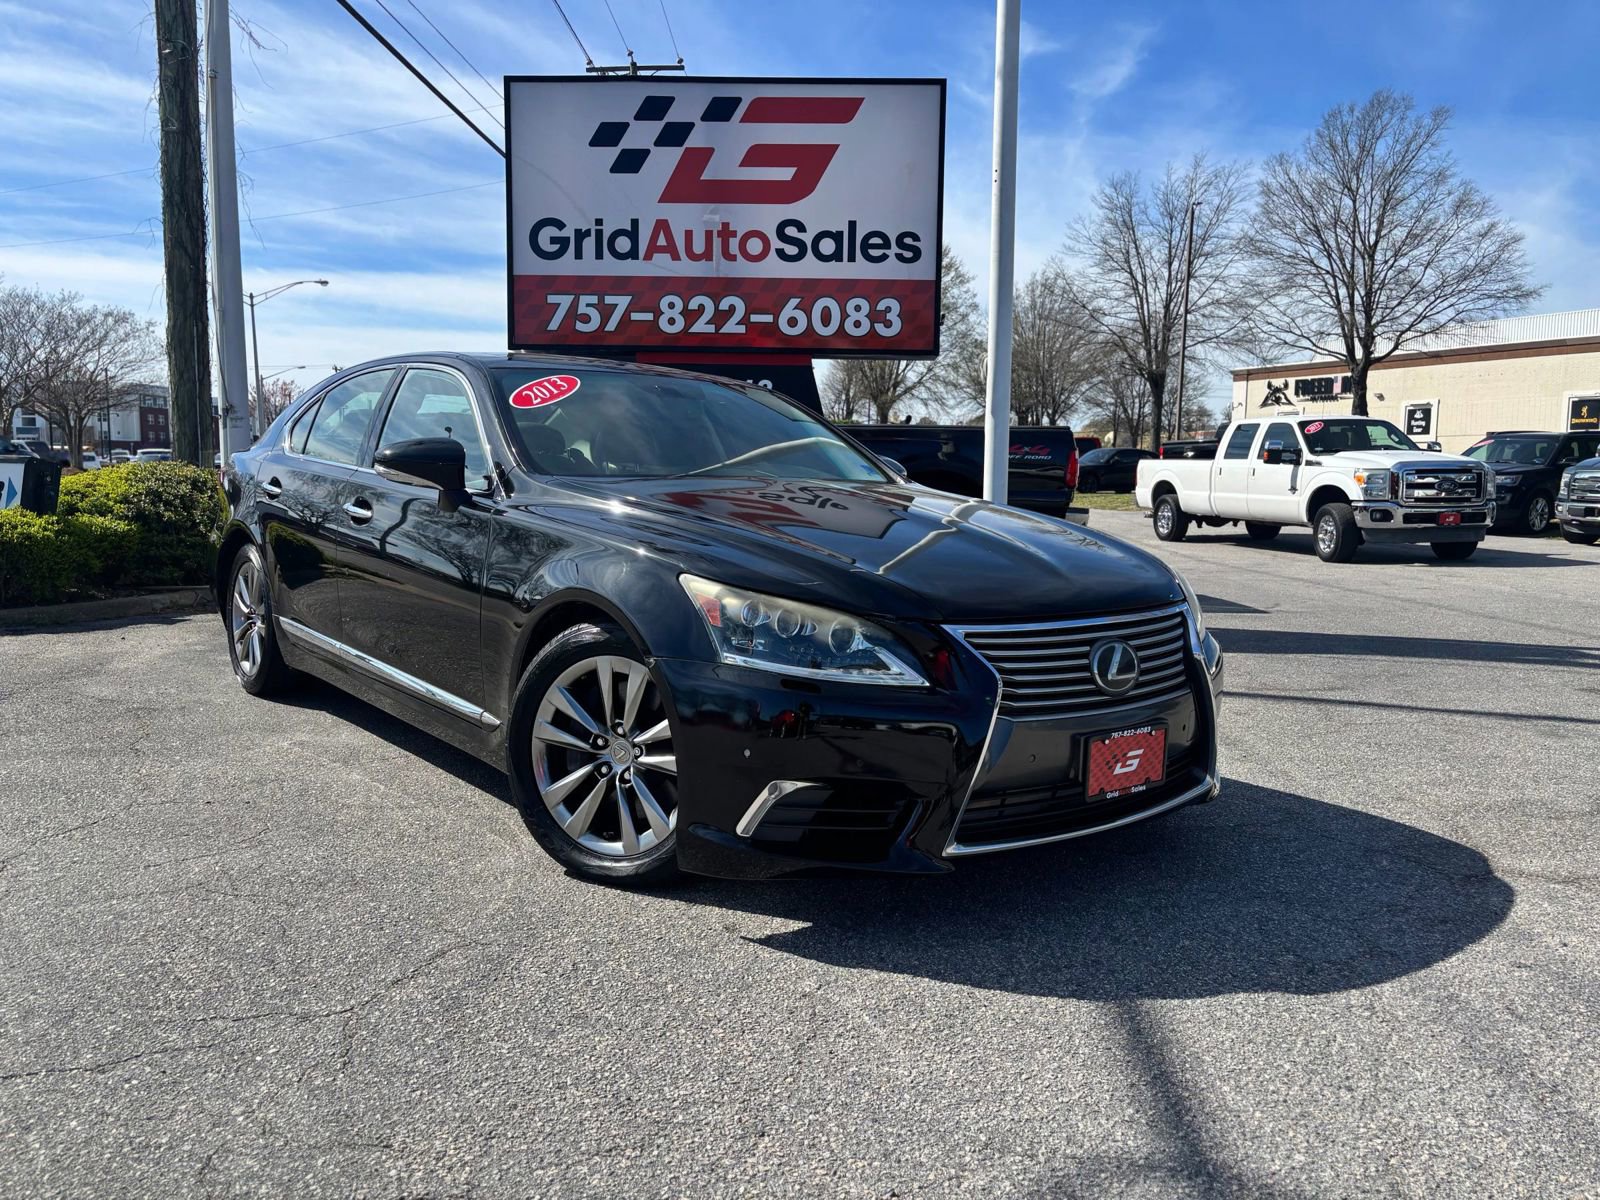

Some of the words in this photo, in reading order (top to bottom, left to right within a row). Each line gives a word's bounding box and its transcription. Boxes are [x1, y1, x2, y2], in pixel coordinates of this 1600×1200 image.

[545, 294, 903, 338] 757-822-6083
[522, 377, 568, 405] 2013
[1110, 726, 1152, 739] 757-822-6083
